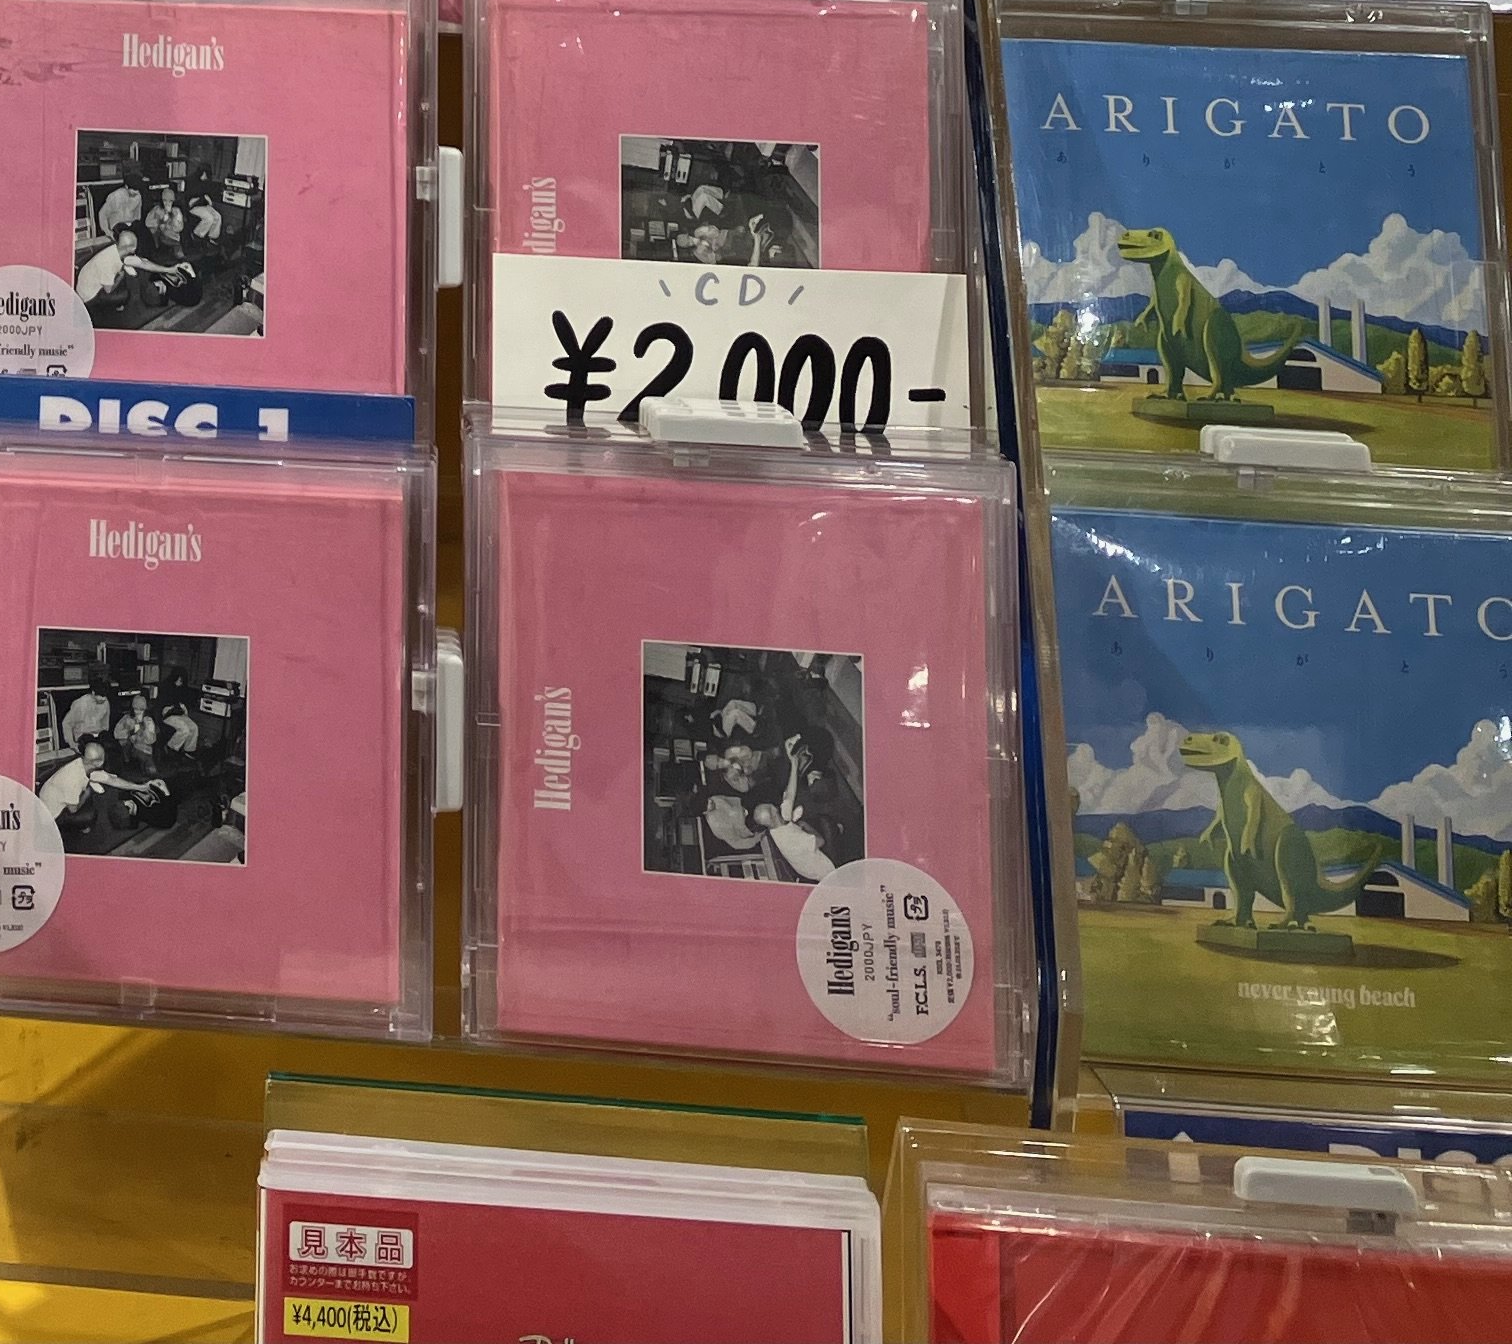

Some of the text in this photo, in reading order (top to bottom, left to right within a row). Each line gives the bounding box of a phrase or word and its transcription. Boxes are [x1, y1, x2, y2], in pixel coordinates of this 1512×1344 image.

[122, 33, 225, 78] Hedigan's
[1040, 92, 1431, 145] ARIGATO
[523, 176, 566, 254] digan's
[89, 518, 203, 571] Hedigan's
[534, 685, 582, 812] Hedigan's
[829, 906, 860, 997] Hedigan's
[1237, 981, 1416, 1010] never young beach
[297, 1225, 404, 1265] 見本品
[292, 1303, 398, 1334] ¥4,400(税込)
